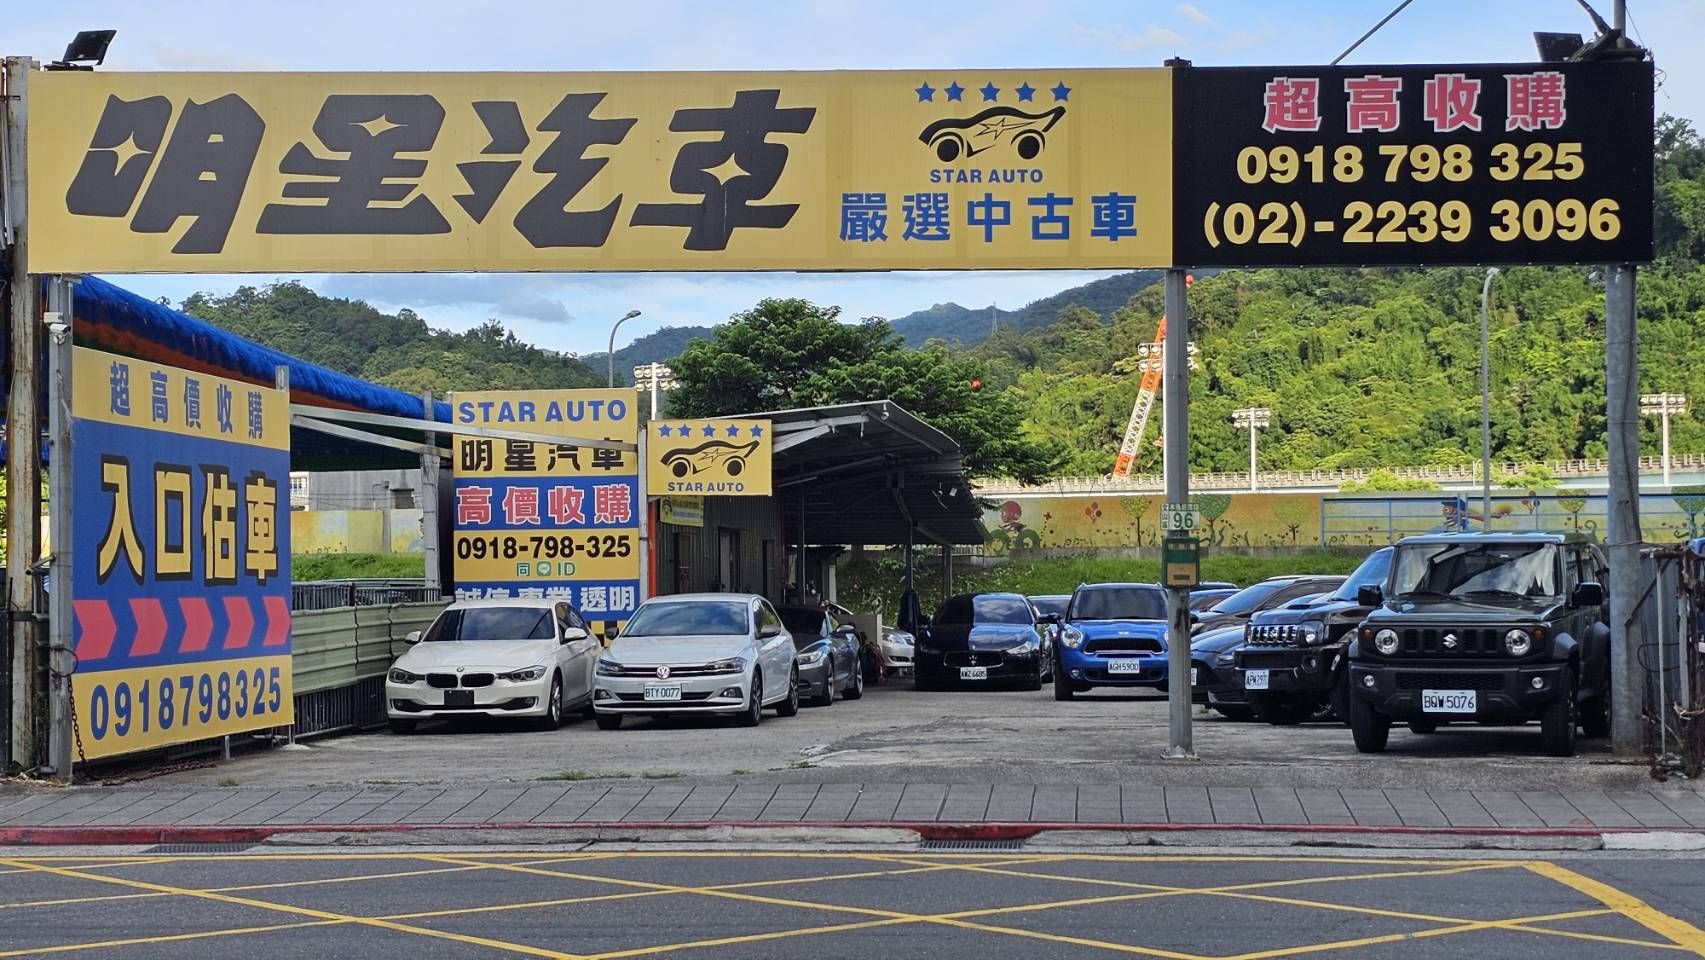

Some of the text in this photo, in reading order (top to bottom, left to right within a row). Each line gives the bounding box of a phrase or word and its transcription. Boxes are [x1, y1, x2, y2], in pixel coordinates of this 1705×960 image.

[1262, 71, 1568, 134] 超高收購
[66, 89, 818, 254] 明星汽車
[930, 169, 1044, 185] STAR AUTO
[1236, 142, 1585, 186] 0918 798 325
[839, 192, 1138, 244] 嚴選中古車
[1489, 198, 1622, 243] 3096
[110, 361, 263, 438] 超高價收購
[459, 399, 627, 424] STAR AUTO
[456, 484, 631, 525] 高價收購
[667, 482, 744, 492] STAR AUTO
[97, 455, 278, 587] 入口估車
[1173, 512, 1194, 529] 96
[457, 534, 631, 560] 0918-798-325
[516, 563, 531, 577] 同
[557, 562, 576, 576] ID
[580, 586, 635, 612] 透明
[90, 667, 281, 741] 0918798325
